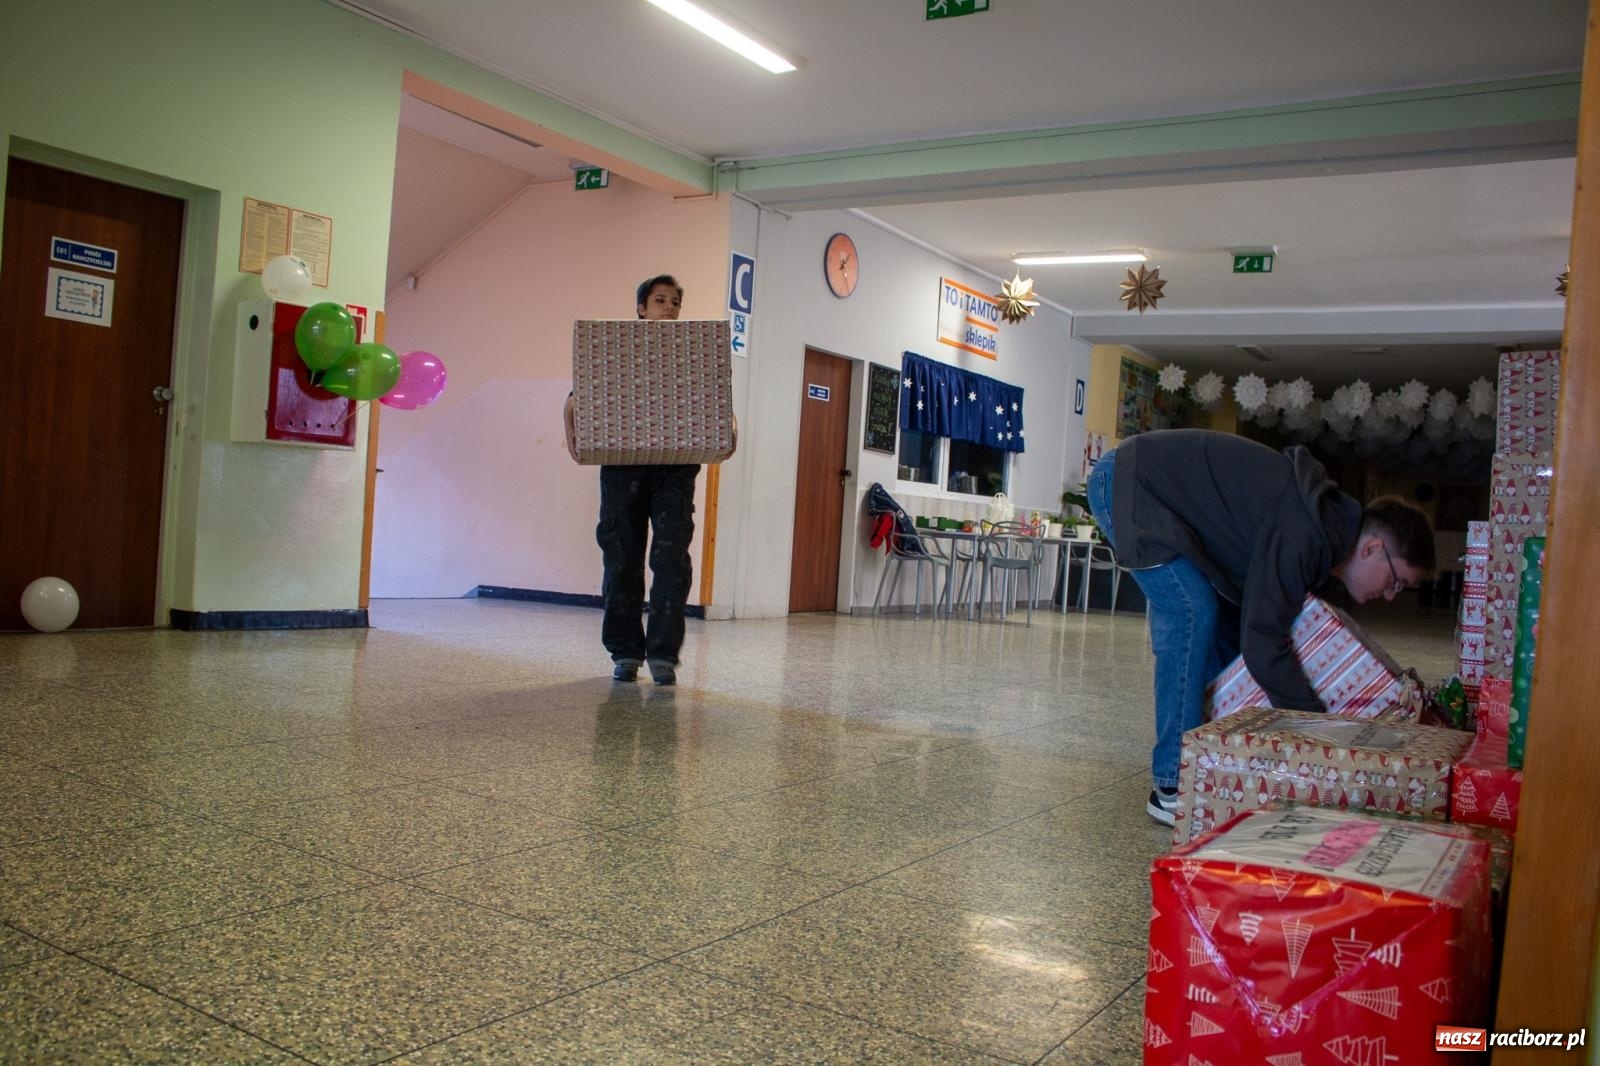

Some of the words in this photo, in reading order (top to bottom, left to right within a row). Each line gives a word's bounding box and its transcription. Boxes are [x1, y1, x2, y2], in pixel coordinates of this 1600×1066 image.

[735, 263, 751, 308] C
[945, 285, 958, 306] TO
[965, 294, 998, 322] TAMTO
[965, 327, 996, 351] sklepik
[1076, 383, 1083, 411] D
